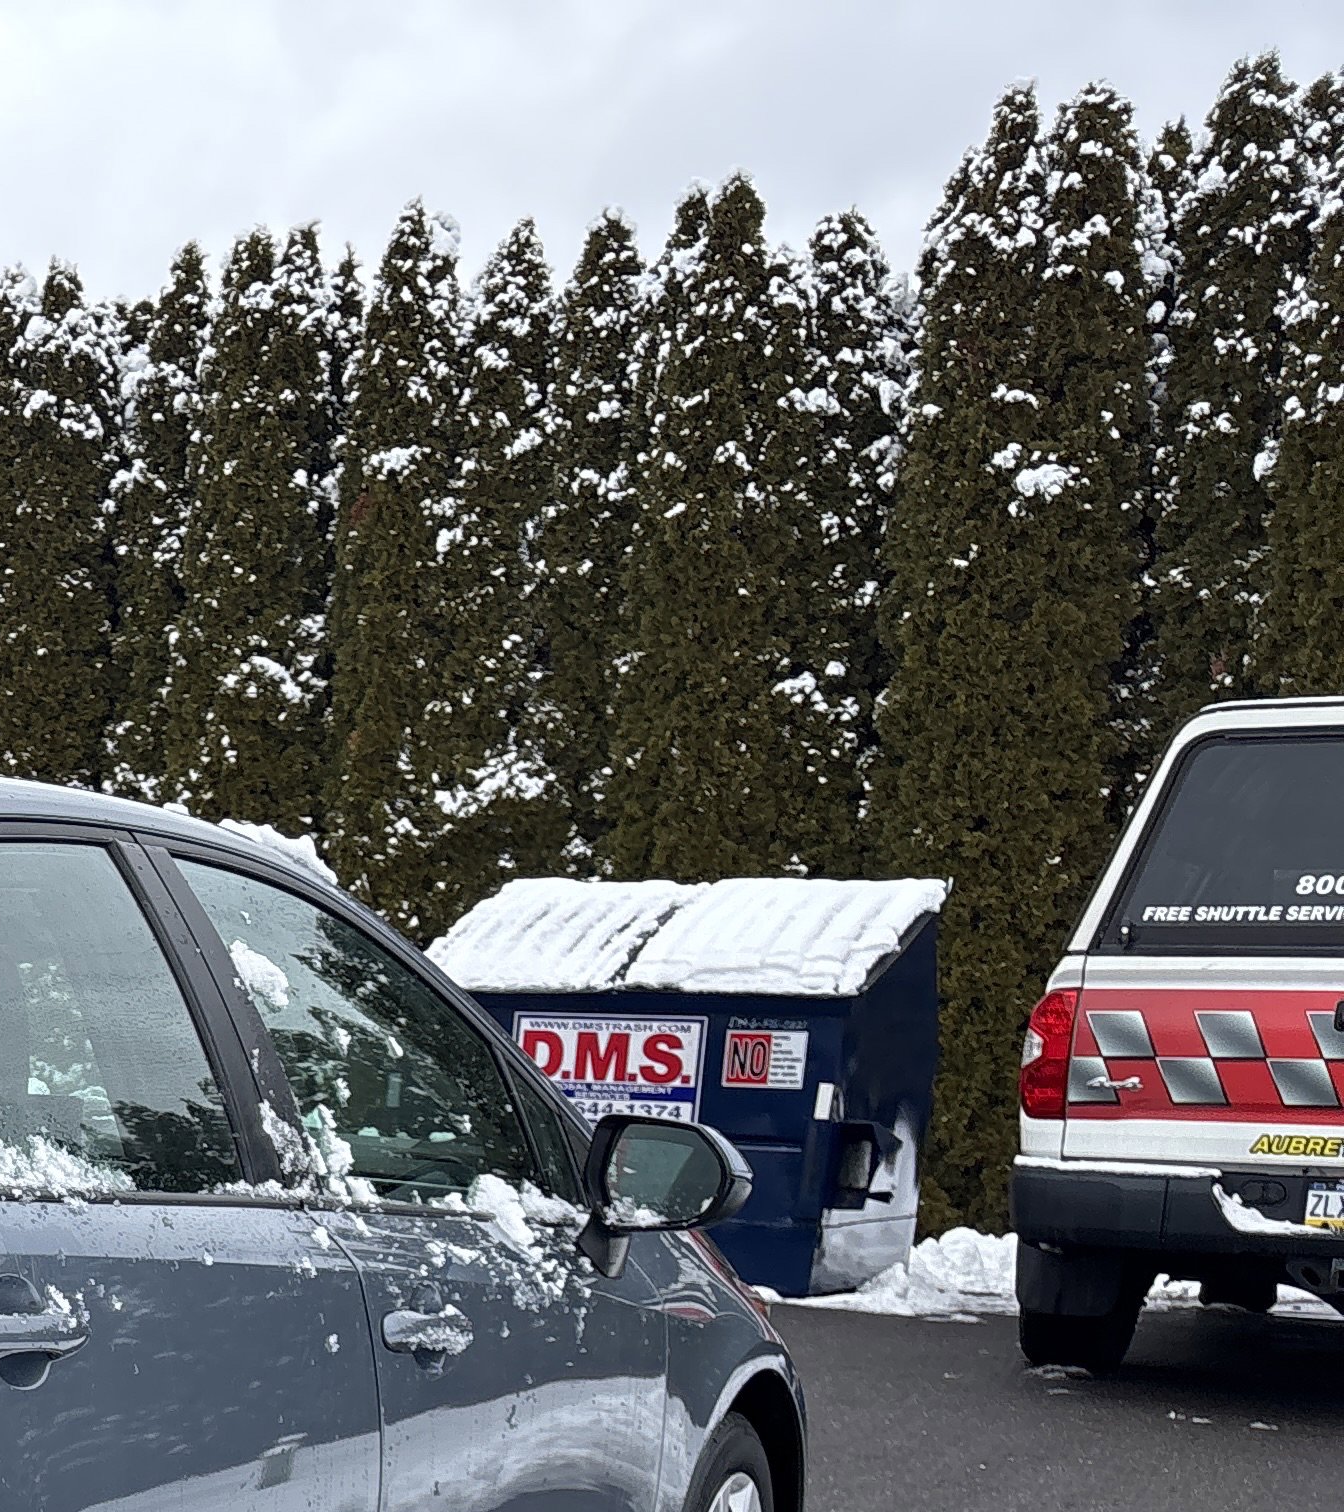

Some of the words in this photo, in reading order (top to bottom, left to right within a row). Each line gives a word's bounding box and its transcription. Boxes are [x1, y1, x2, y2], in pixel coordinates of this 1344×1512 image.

[1142, 905, 1193, 921] FREE
[1194, 905, 1284, 921] SHUTTLE
[1285, 905, 1344, 921] SERVI
[529, 1020, 693, 1034] WWW.DMSTRASH.COM
[523, 1030, 692, 1085] D.M.S.
[728, 1038, 769, 1079] NO
[1249, 1133, 1344, 1158] AUBRE
